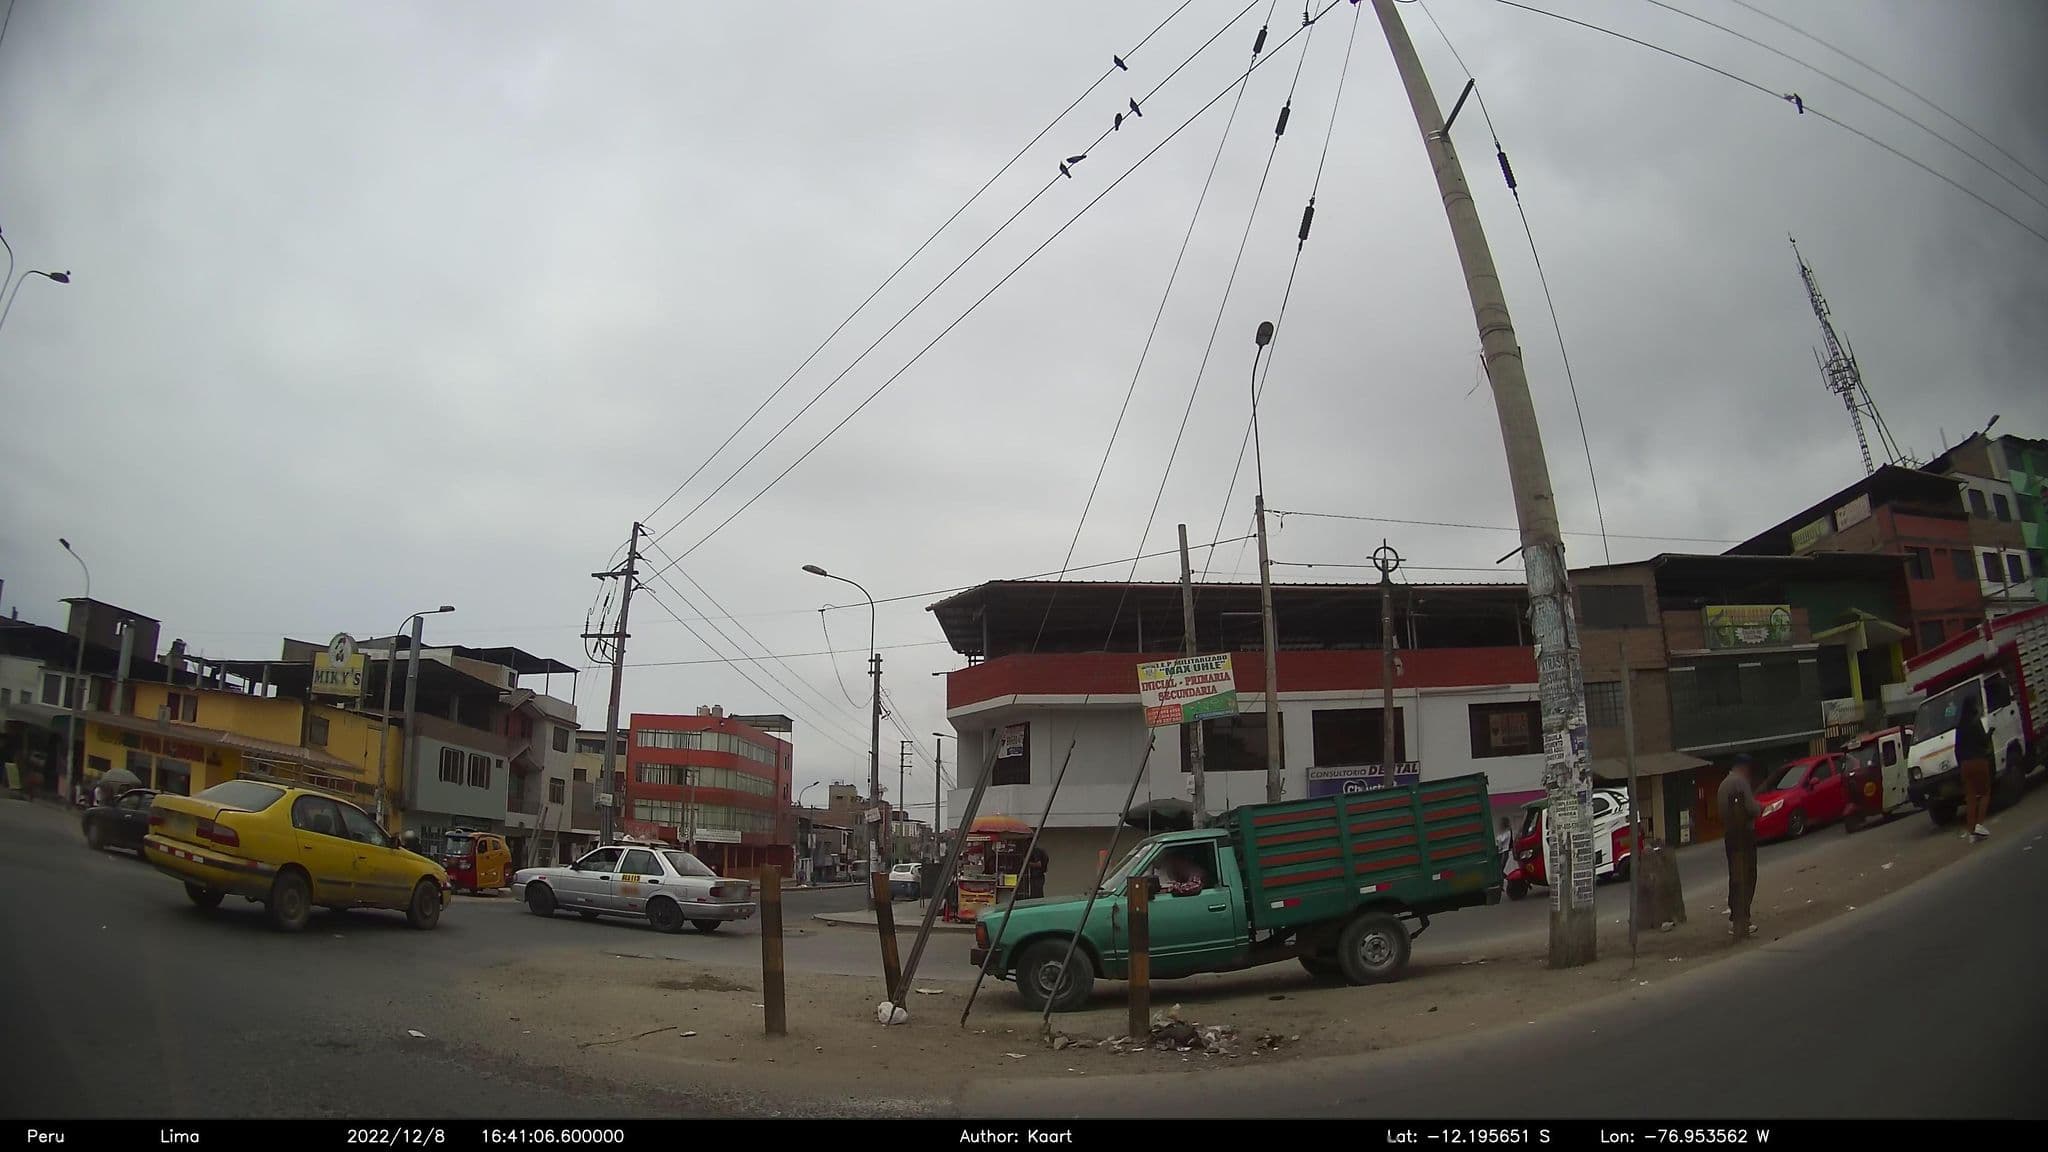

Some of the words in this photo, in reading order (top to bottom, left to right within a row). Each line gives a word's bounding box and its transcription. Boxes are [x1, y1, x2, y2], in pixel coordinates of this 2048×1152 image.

[1141, 679, 1177, 691] INICIAL
[1185, 672, 1231, 686] PRIMARIA
[1158, 685, 1218, 702] SECUNDARIA
[1310, 767, 1368, 779] CONSULTORIO
[1368, 763, 1419, 776] DETAL
